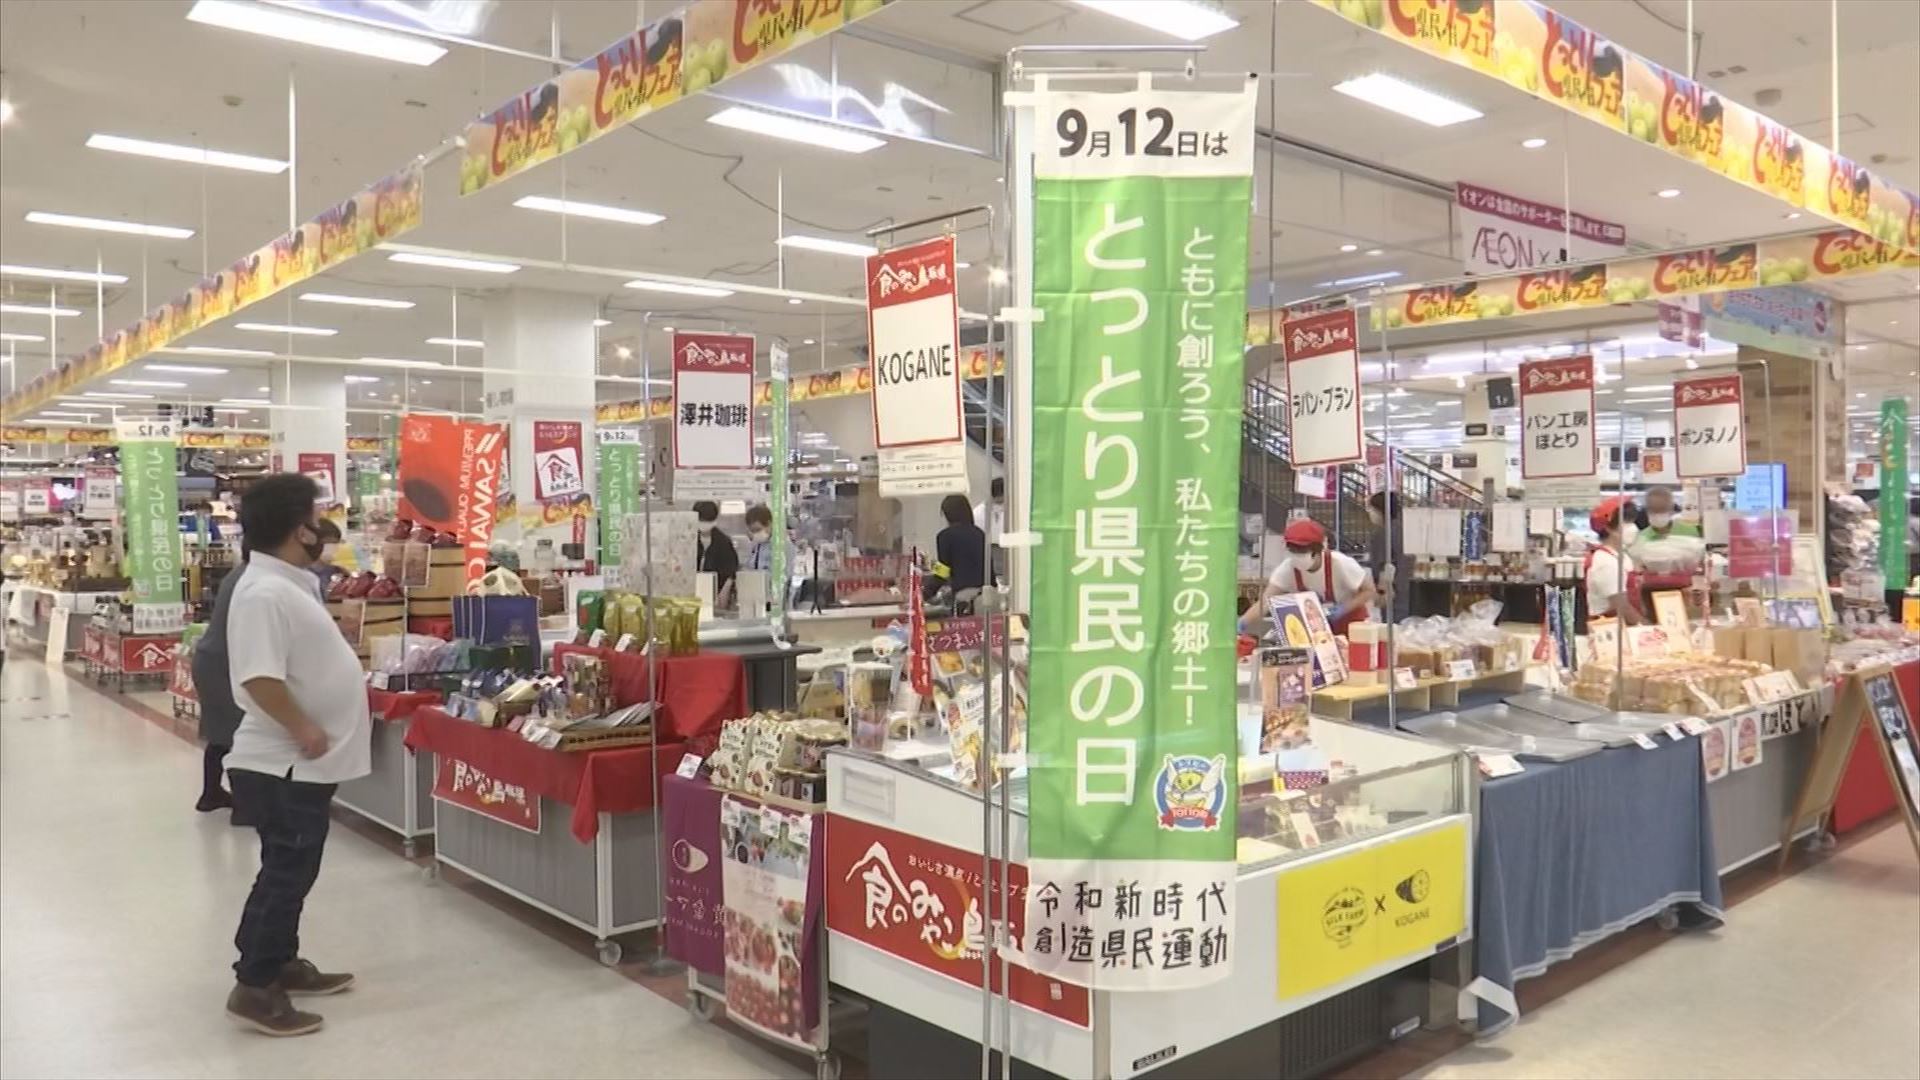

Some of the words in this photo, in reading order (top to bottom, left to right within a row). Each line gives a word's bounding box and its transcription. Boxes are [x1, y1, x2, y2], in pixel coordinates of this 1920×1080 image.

[1056, 107, 1229, 158] 9月12日は
[877, 344, 952, 385] KOGANE
[680, 403, 748, 427] 澤井珈琲
[1526, 411, 1588, 431] パン工房
[1535, 432, 1579, 450] ほとり
[1070, 202, 1151, 807] とっとり県民の日
[1036, 880, 1228, 921] 令和新時代
[1033, 921, 1228, 970] 創造県民運動
